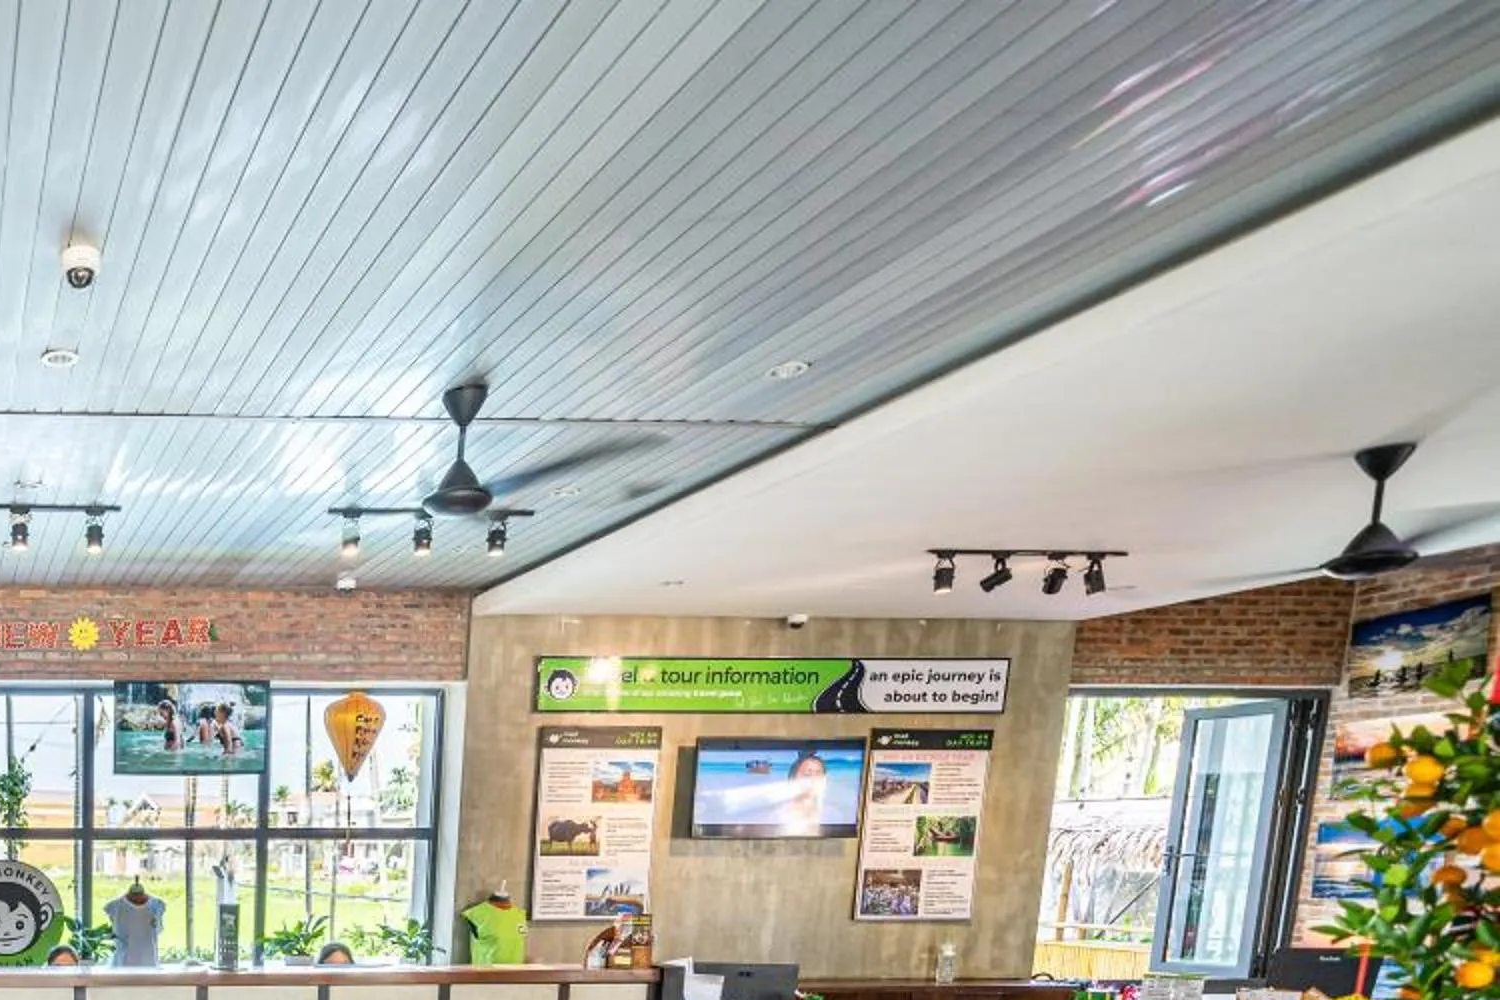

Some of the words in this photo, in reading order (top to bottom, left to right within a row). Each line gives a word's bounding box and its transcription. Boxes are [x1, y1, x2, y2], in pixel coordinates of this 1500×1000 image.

[108, 616, 210, 648] YEAR
[661, 669, 700, 684] tour
[705, 667, 820, 685] information
[869, 672, 888, 682] an
[891, 669, 923, 687] epic
[926, 669, 985, 687] journey
[989, 668, 1001, 682] is
[883, 690, 927, 703] about
[931, 692, 948, 703] to
[951, 690, 999, 704] begin!
